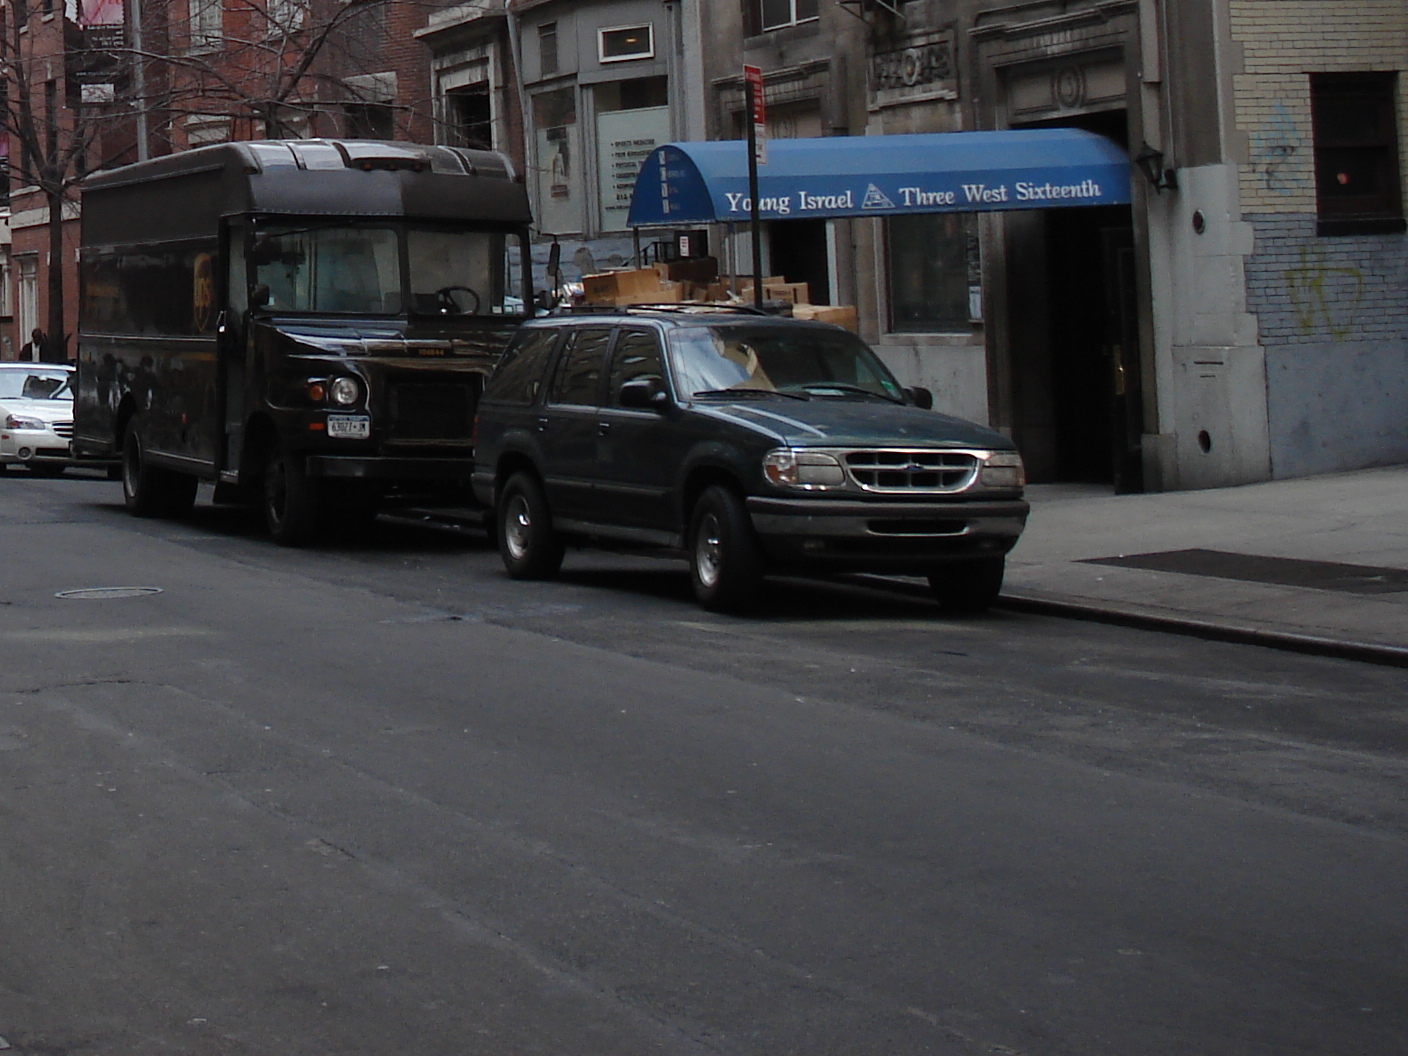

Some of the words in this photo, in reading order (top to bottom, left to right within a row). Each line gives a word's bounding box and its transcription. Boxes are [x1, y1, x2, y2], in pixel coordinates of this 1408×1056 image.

[799, 191, 853, 210] Israel
[899, 187, 955, 206] Three
[962, 184, 1008, 202] West
[1016, 179, 1101, 201] Sixteenth
